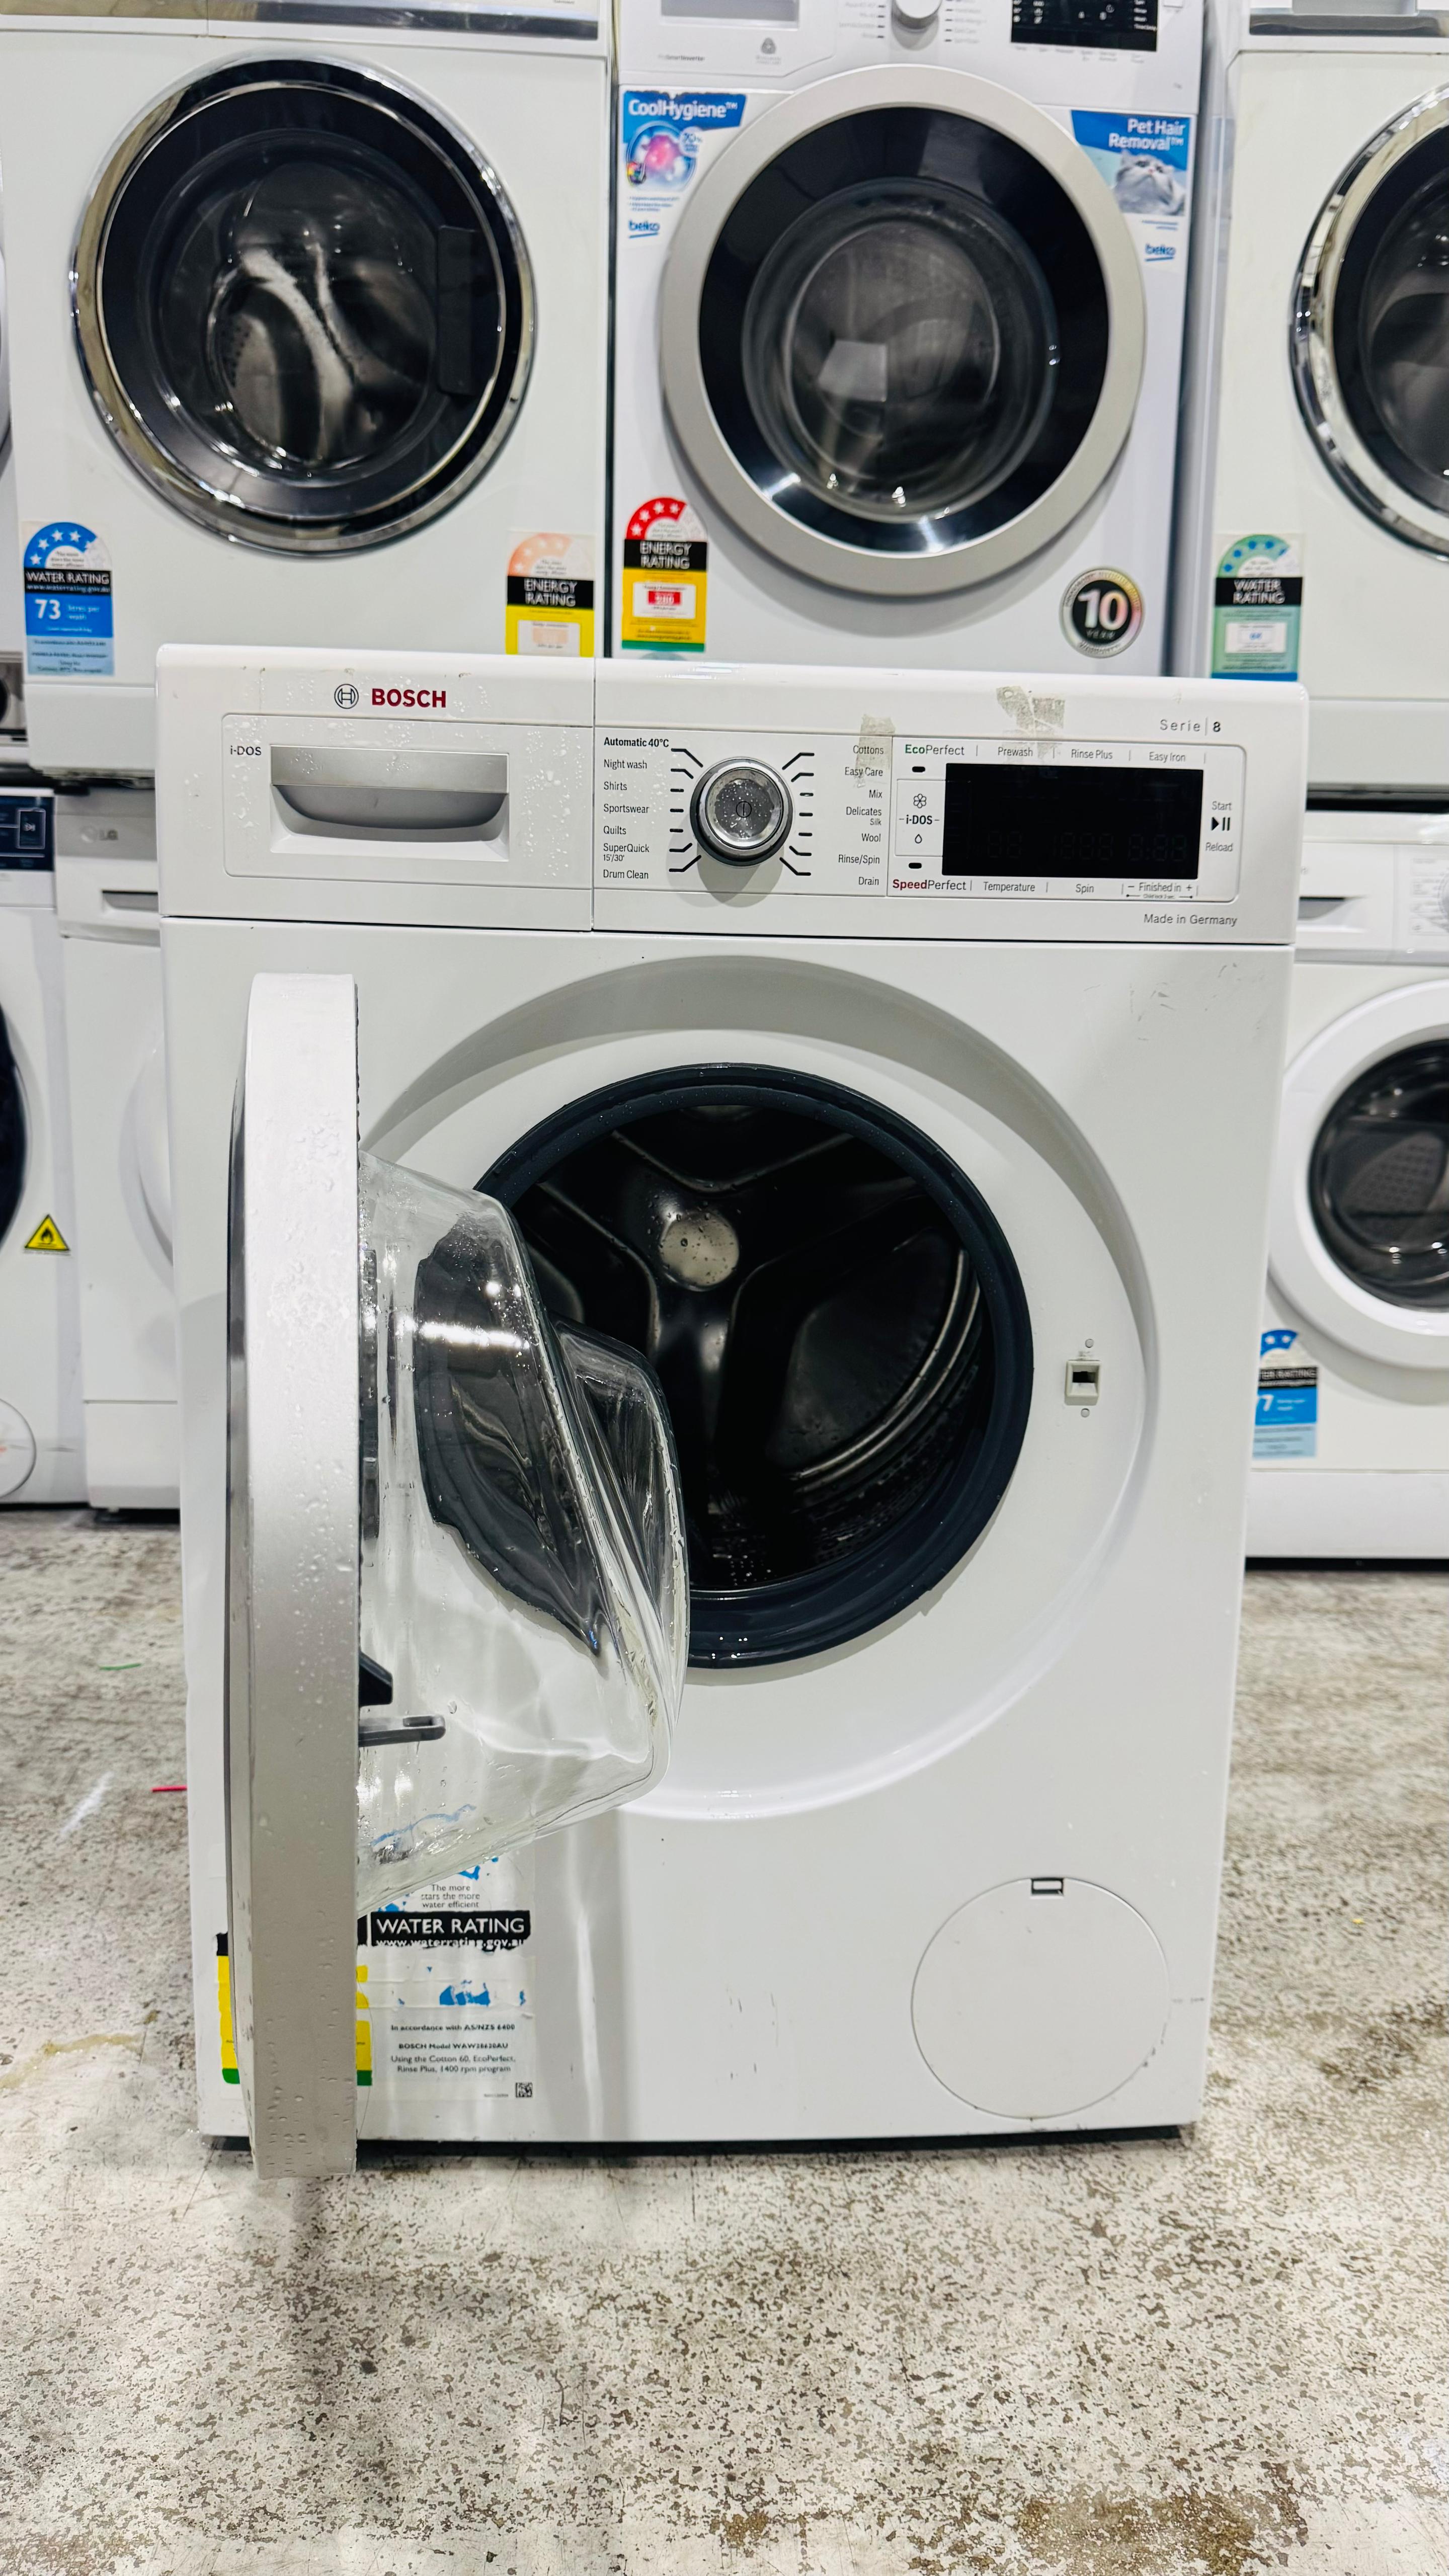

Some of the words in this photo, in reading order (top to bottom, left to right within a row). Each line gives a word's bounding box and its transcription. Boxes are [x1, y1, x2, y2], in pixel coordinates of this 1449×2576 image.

[1127, 118, 1153, 134] Pet
[1154, 120, 1186, 136] Hair
[628, 220, 660, 231] beko
[1145, 244, 1176, 256] beko
[639, 541, 692, 556] ENERGY
[640, 554, 690, 570] RATING
[26, 571, 65, 583] WATER
[66, 573, 110, 585] RATING
[524, 578, 578, 594] ENERGY
[1234, 579, 1282, 592] WATER
[525, 591, 577, 607] RATING
[1233, 591, 1285, 604] RATING
[35, 599, 61, 620] 73
[1077, 589, 1129, 631] 10
[371, 688, 446, 708] BOSCH
[1159, 719, 1201, 732] Serie
[1213, 721, 1221, 732] 8
[603, 737, 647, 747] Automatic
[648, 738, 669, 748] 40°C
[230, 745, 262, 756] i-DOS
[853, 745, 884, 755] Cottons
[905, 744, 965, 756] EcoPerfect
[998, 747, 1033, 757] Prewash
[1071, 749, 1094, 759] Rinse
[1095, 749, 1113, 759] Plus
[1149, 752, 1168, 763] Easy
[1170, 752, 1186, 762] Iron
[603, 759, 625, 770] Night
[626, 760, 648, 769] wash
[845, 766, 863, 778] Easy
[865, 767, 883, 776] Care
[603, 781, 627, 790] Shirts
[868, 789, 883, 798] Mix
[603, 803, 650, 814] Sportswear
[846, 806, 882, 816] Delicates
[1212, 801, 1232, 811] Start
[906, 814, 933, 825] i-DOS
[603, 825, 627, 835] Quilts
[861, 833, 881, 842] Wool
[603, 843, 650, 854] SuperQuick
[1205, 842, 1234, 852] Reload
[838, 854, 880, 866] Rinse/Spin
[603, 869, 625, 878] Drum
[626, 870, 649, 879] Clean
[858, 876, 879, 886] Drain
[892, 878, 967, 891] SpeedPerfect
[983, 881, 1036, 893] Temperature
[1075, 884, 1095, 895] Spin
[1139, 882, 1172, 893] Finished
[1174, 883, 1182, 893] in
[1143, 914, 1174, 925] Made
[1176, 914, 1186, 925] in
[1189, 915, 1238, 927] Germany
[432, 1884, 446, 1892] The
[443, 1892, 456, 1900] the
[448, 1900, 479, 1908] efficient
[376, 1918, 445, 1935] WATER
[451, 1917, 525, 1934] RATING
[391, 2055, 413, 2064] Using
